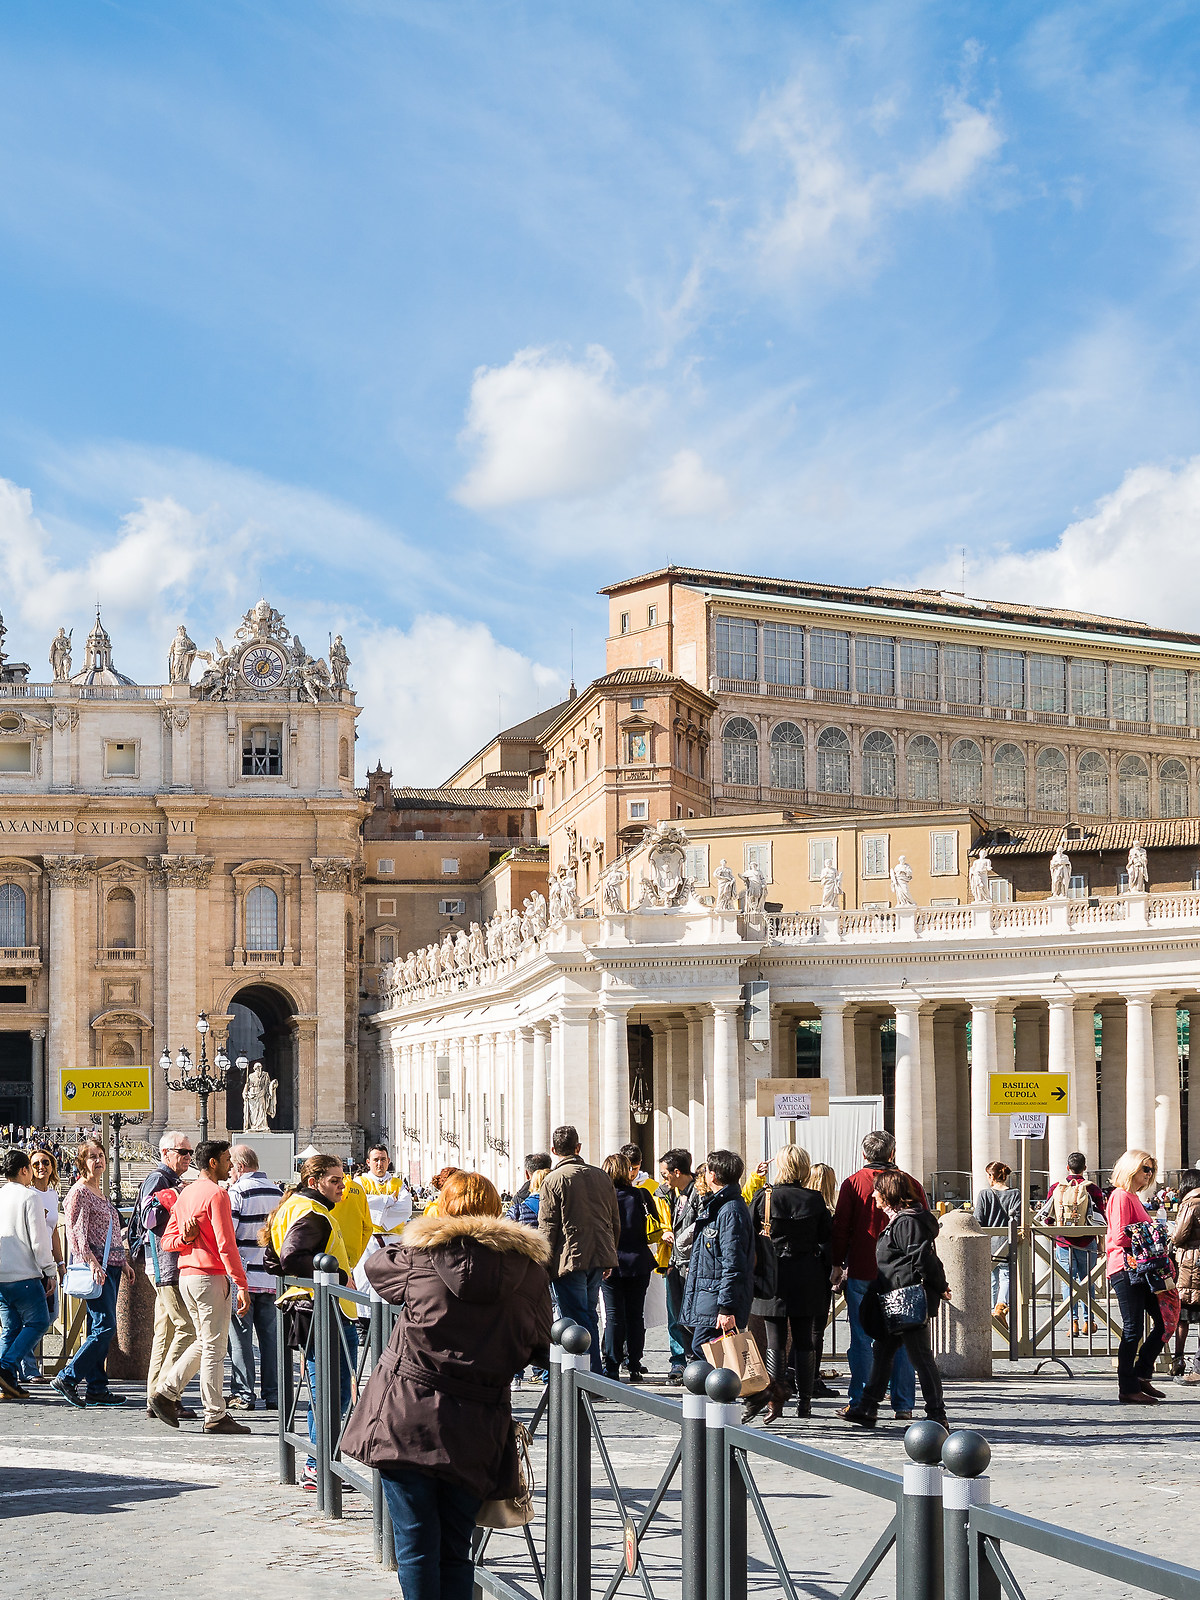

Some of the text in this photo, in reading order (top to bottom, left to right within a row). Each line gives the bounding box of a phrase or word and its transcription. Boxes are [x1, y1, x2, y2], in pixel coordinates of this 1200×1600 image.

[170, 820, 195, 833] VII
[82, 1080, 144, 1089] PORTA SANTA
